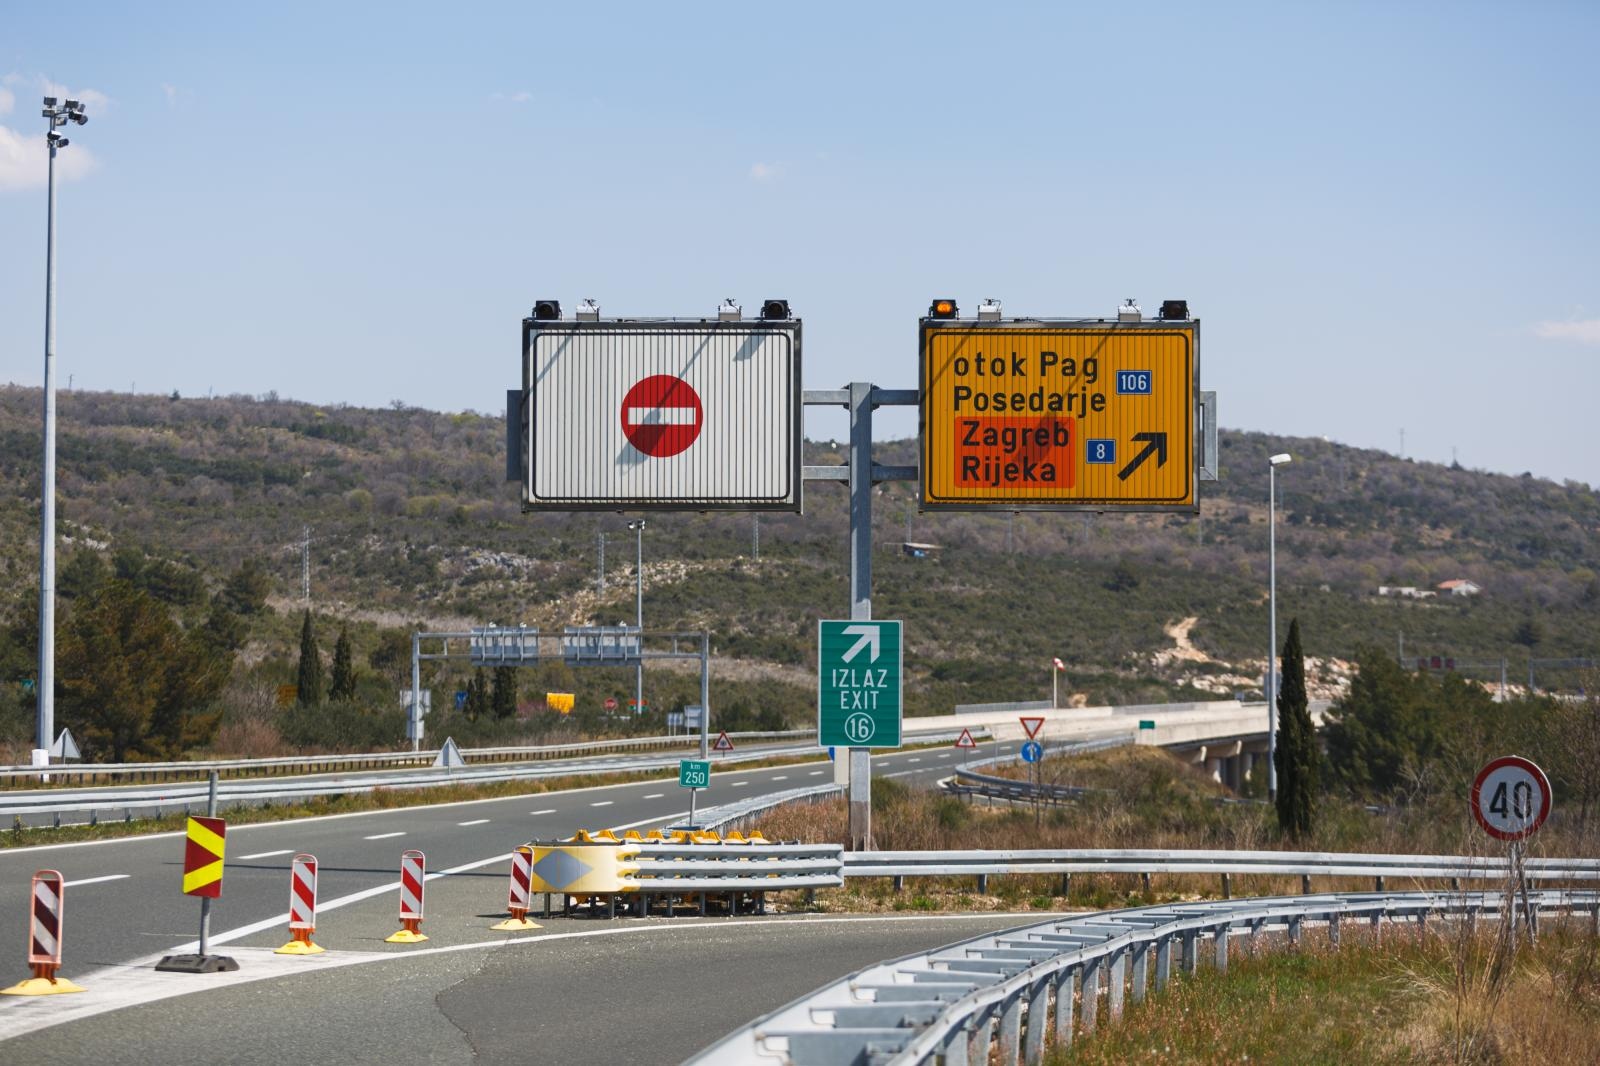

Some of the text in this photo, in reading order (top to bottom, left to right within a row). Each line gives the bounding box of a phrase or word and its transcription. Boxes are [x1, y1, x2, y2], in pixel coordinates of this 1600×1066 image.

[954, 351, 1099, 384] otok Pag
[1121, 374, 1147, 391] 106
[954, 386, 1107, 419] Posedarje
[962, 421, 1069, 453] Zagreb
[1096, 443, 1105, 460] 8
[962, 455, 1056, 487] Rijeka
[832, 669, 888, 688] IZLAZ
[840, 690, 879, 710] EXIT
[850, 718, 869, 738] 16
[690, 762, 701, 770] km
[685, 771, 705, 785] 250
[1489, 781, 1532, 819] 40
